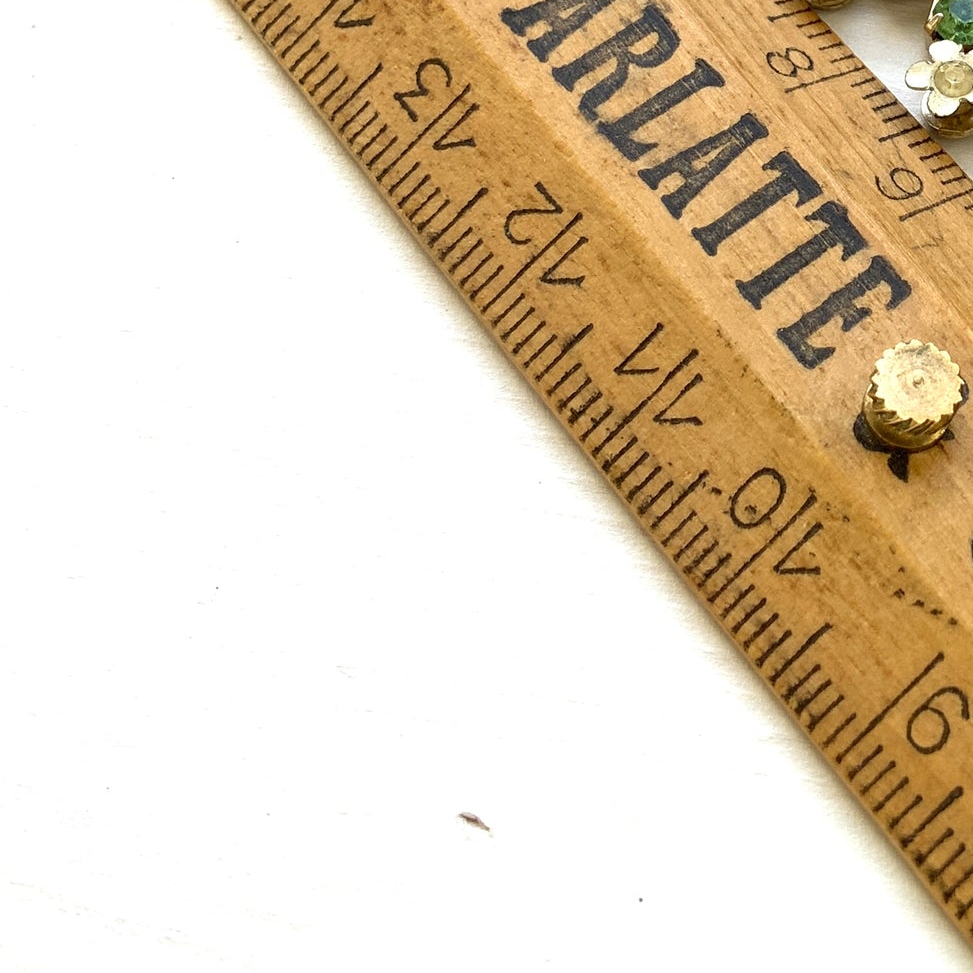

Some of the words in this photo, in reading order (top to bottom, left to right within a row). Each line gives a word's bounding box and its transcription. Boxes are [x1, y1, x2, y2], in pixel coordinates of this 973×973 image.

[393, 57, 481, 151] 13
[765, 46, 815, 80] 8
[874, 166, 925, 201] 9
[502, 180, 590, 287] 12
